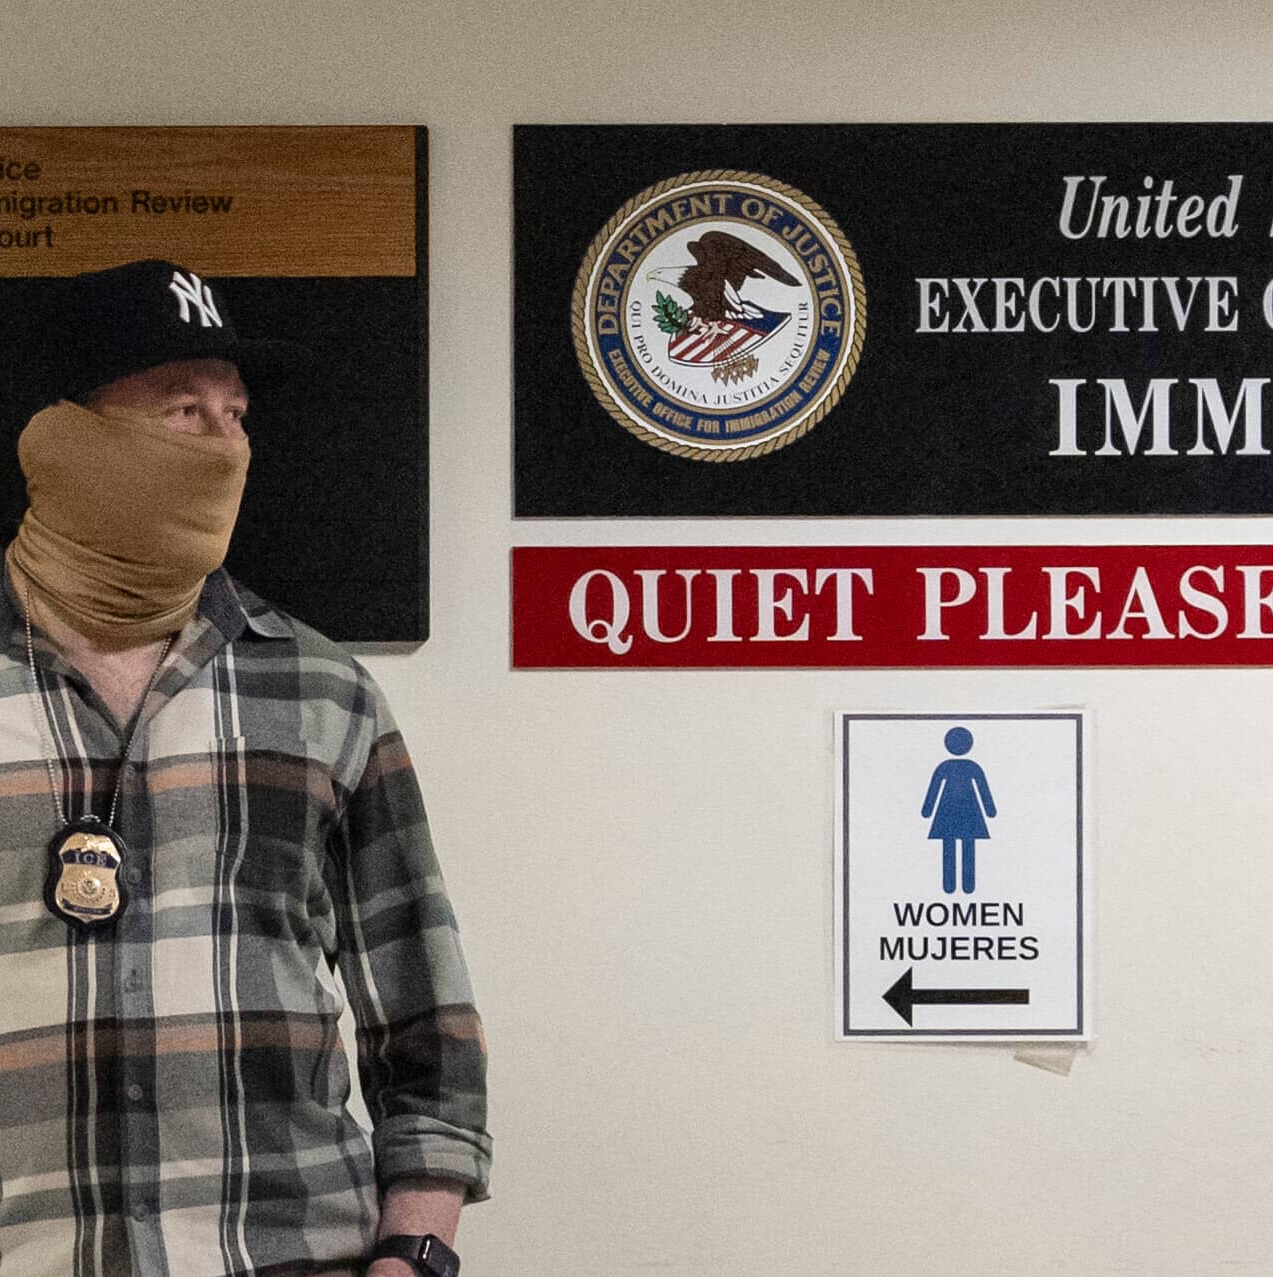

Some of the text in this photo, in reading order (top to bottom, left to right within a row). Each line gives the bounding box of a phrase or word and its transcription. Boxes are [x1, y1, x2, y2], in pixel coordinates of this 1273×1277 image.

[131, 188, 234, 215] Review
[1059, 174, 1244, 240] United
[598, 194, 842, 337] DEPARTMENT OF JUSTICE
[915, 276, 1239, 333] EXECUTIVE
[634, 335, 653, 364] PRO
[697, 419, 720, 434] FOR
[568, 568, 874, 655] QUIET
[893, 902, 1024, 927] WOMEN
[880, 936, 1039, 961] MUJERES
